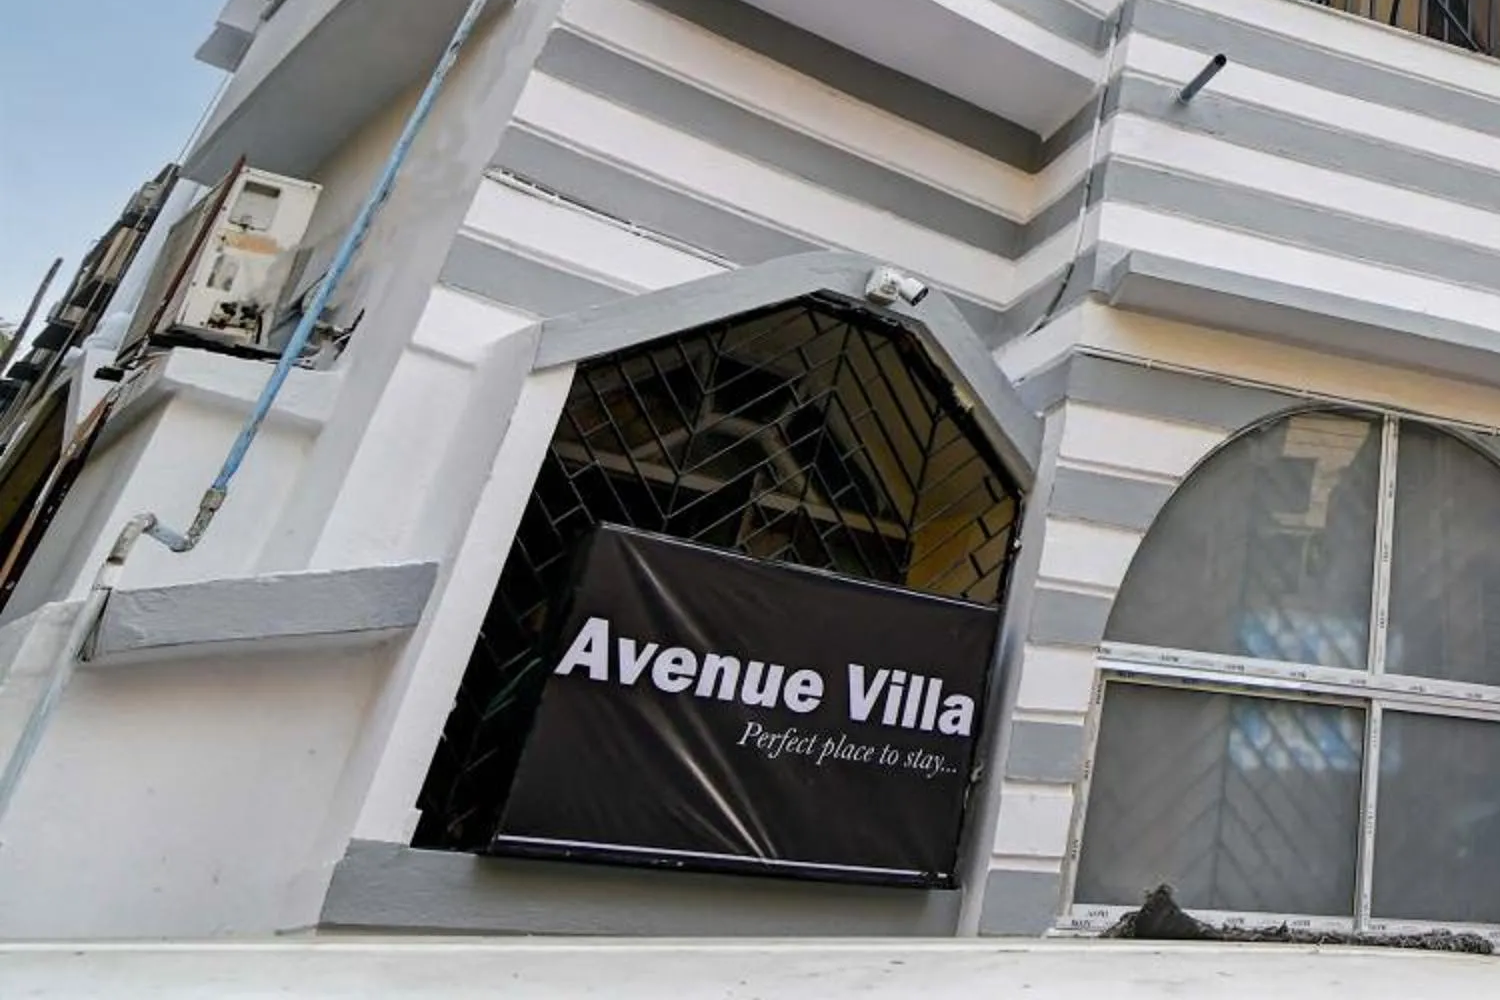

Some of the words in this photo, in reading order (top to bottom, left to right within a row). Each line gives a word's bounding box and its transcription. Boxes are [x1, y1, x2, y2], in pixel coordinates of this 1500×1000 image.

[554, 616, 824, 713] Avenue
[848, 663, 976, 737] Villa
[736, 721, 817, 759] Perfect
[815, 733, 875, 766] place
[879, 743, 899, 766] to
[903, 748, 958, 779] stay...
